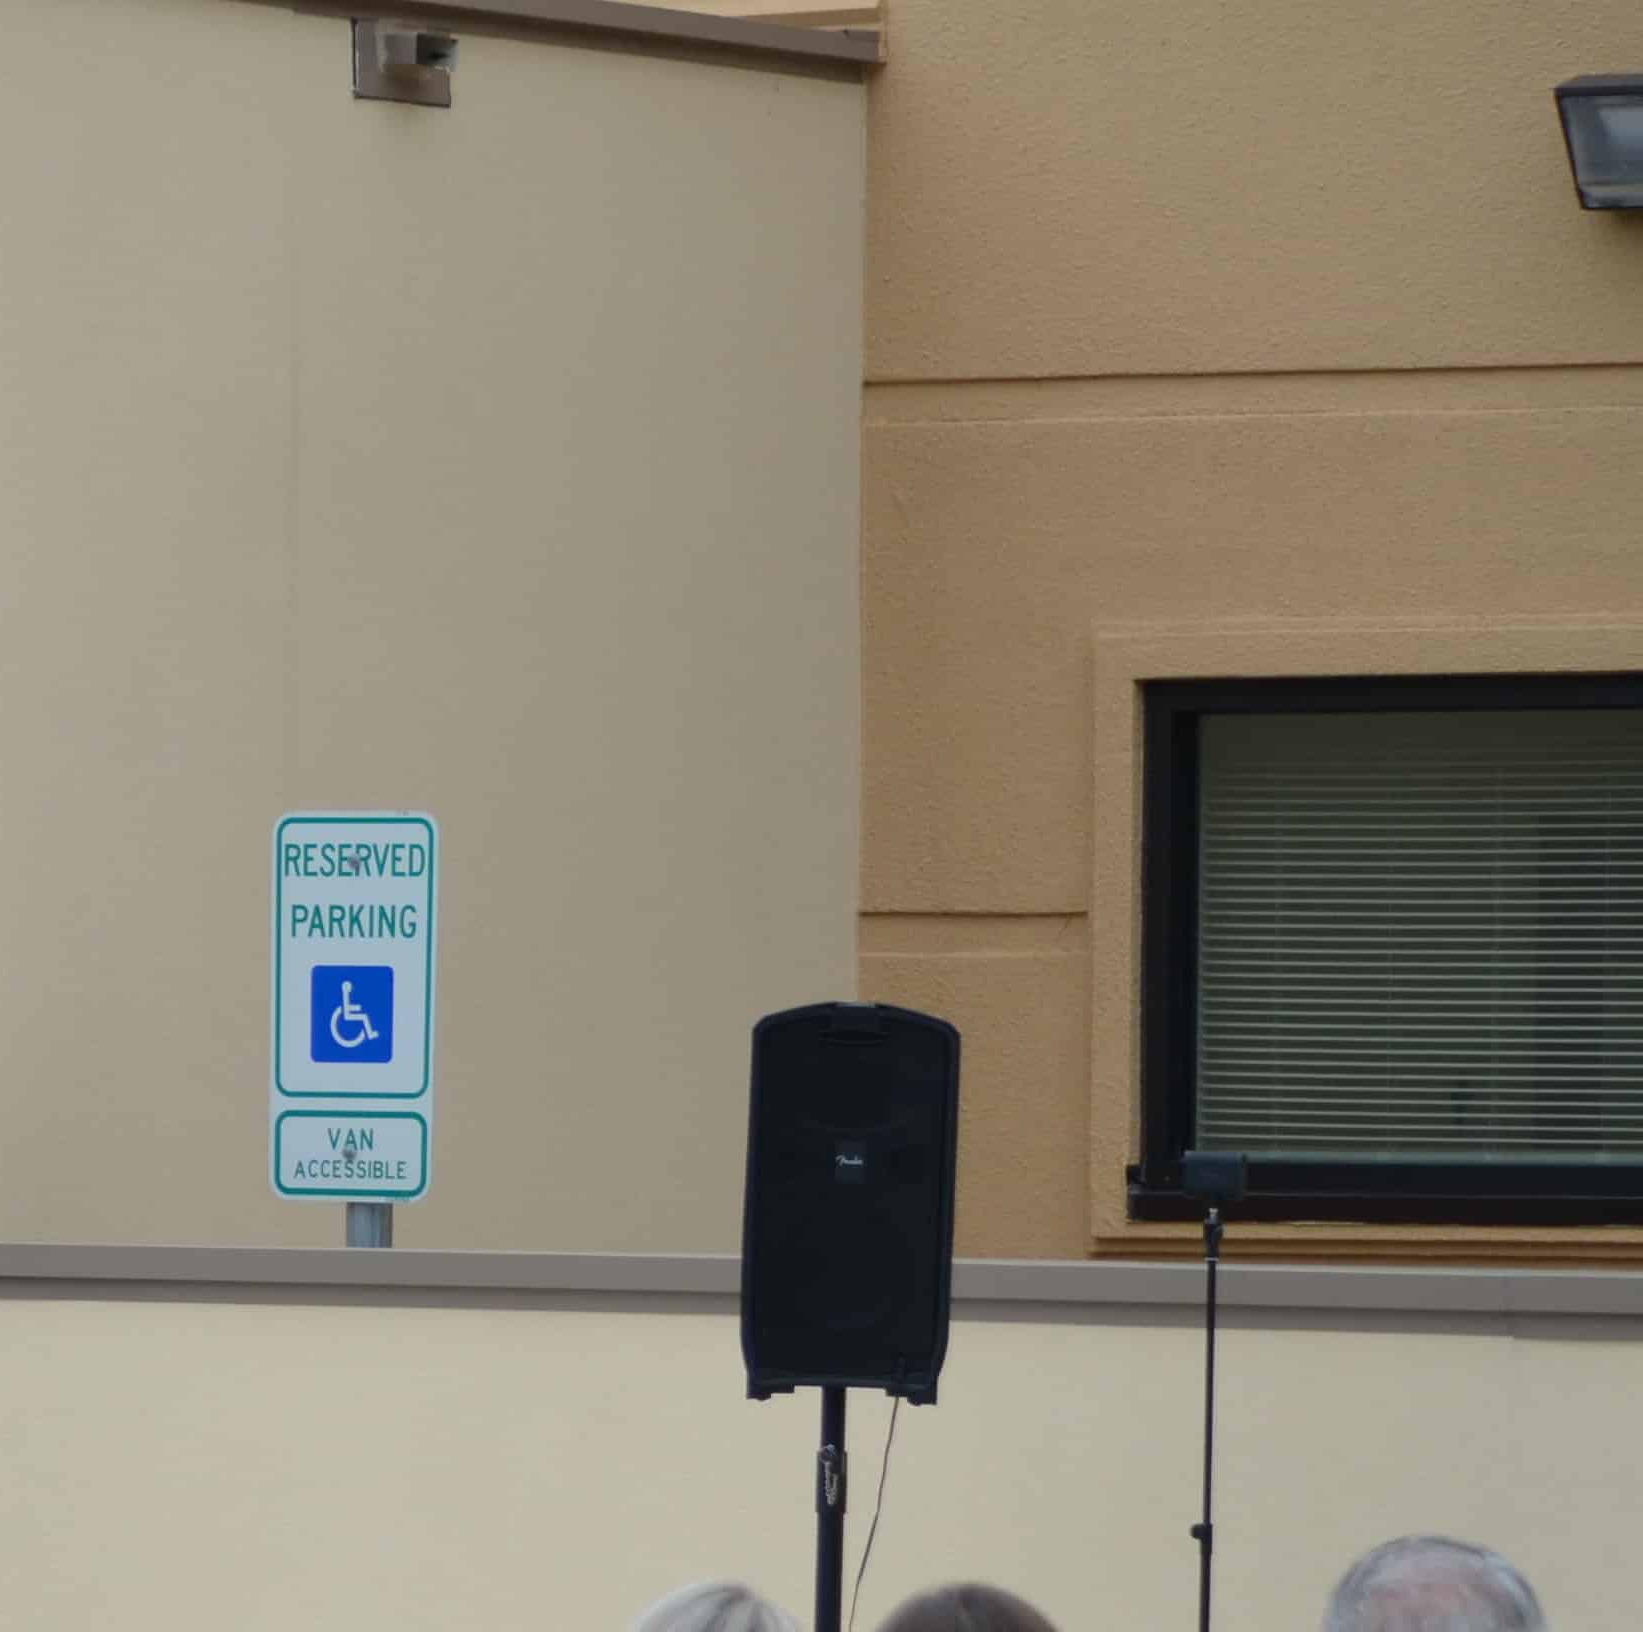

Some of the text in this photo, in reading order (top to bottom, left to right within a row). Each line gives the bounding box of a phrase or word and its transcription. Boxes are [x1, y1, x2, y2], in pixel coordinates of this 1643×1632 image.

[284, 843, 426, 877] RESERVED
[291, 904, 417, 938] PARKING
[327, 1127, 374, 1150] VAN
[293, 1159, 407, 1180] ACCESSIBLE
